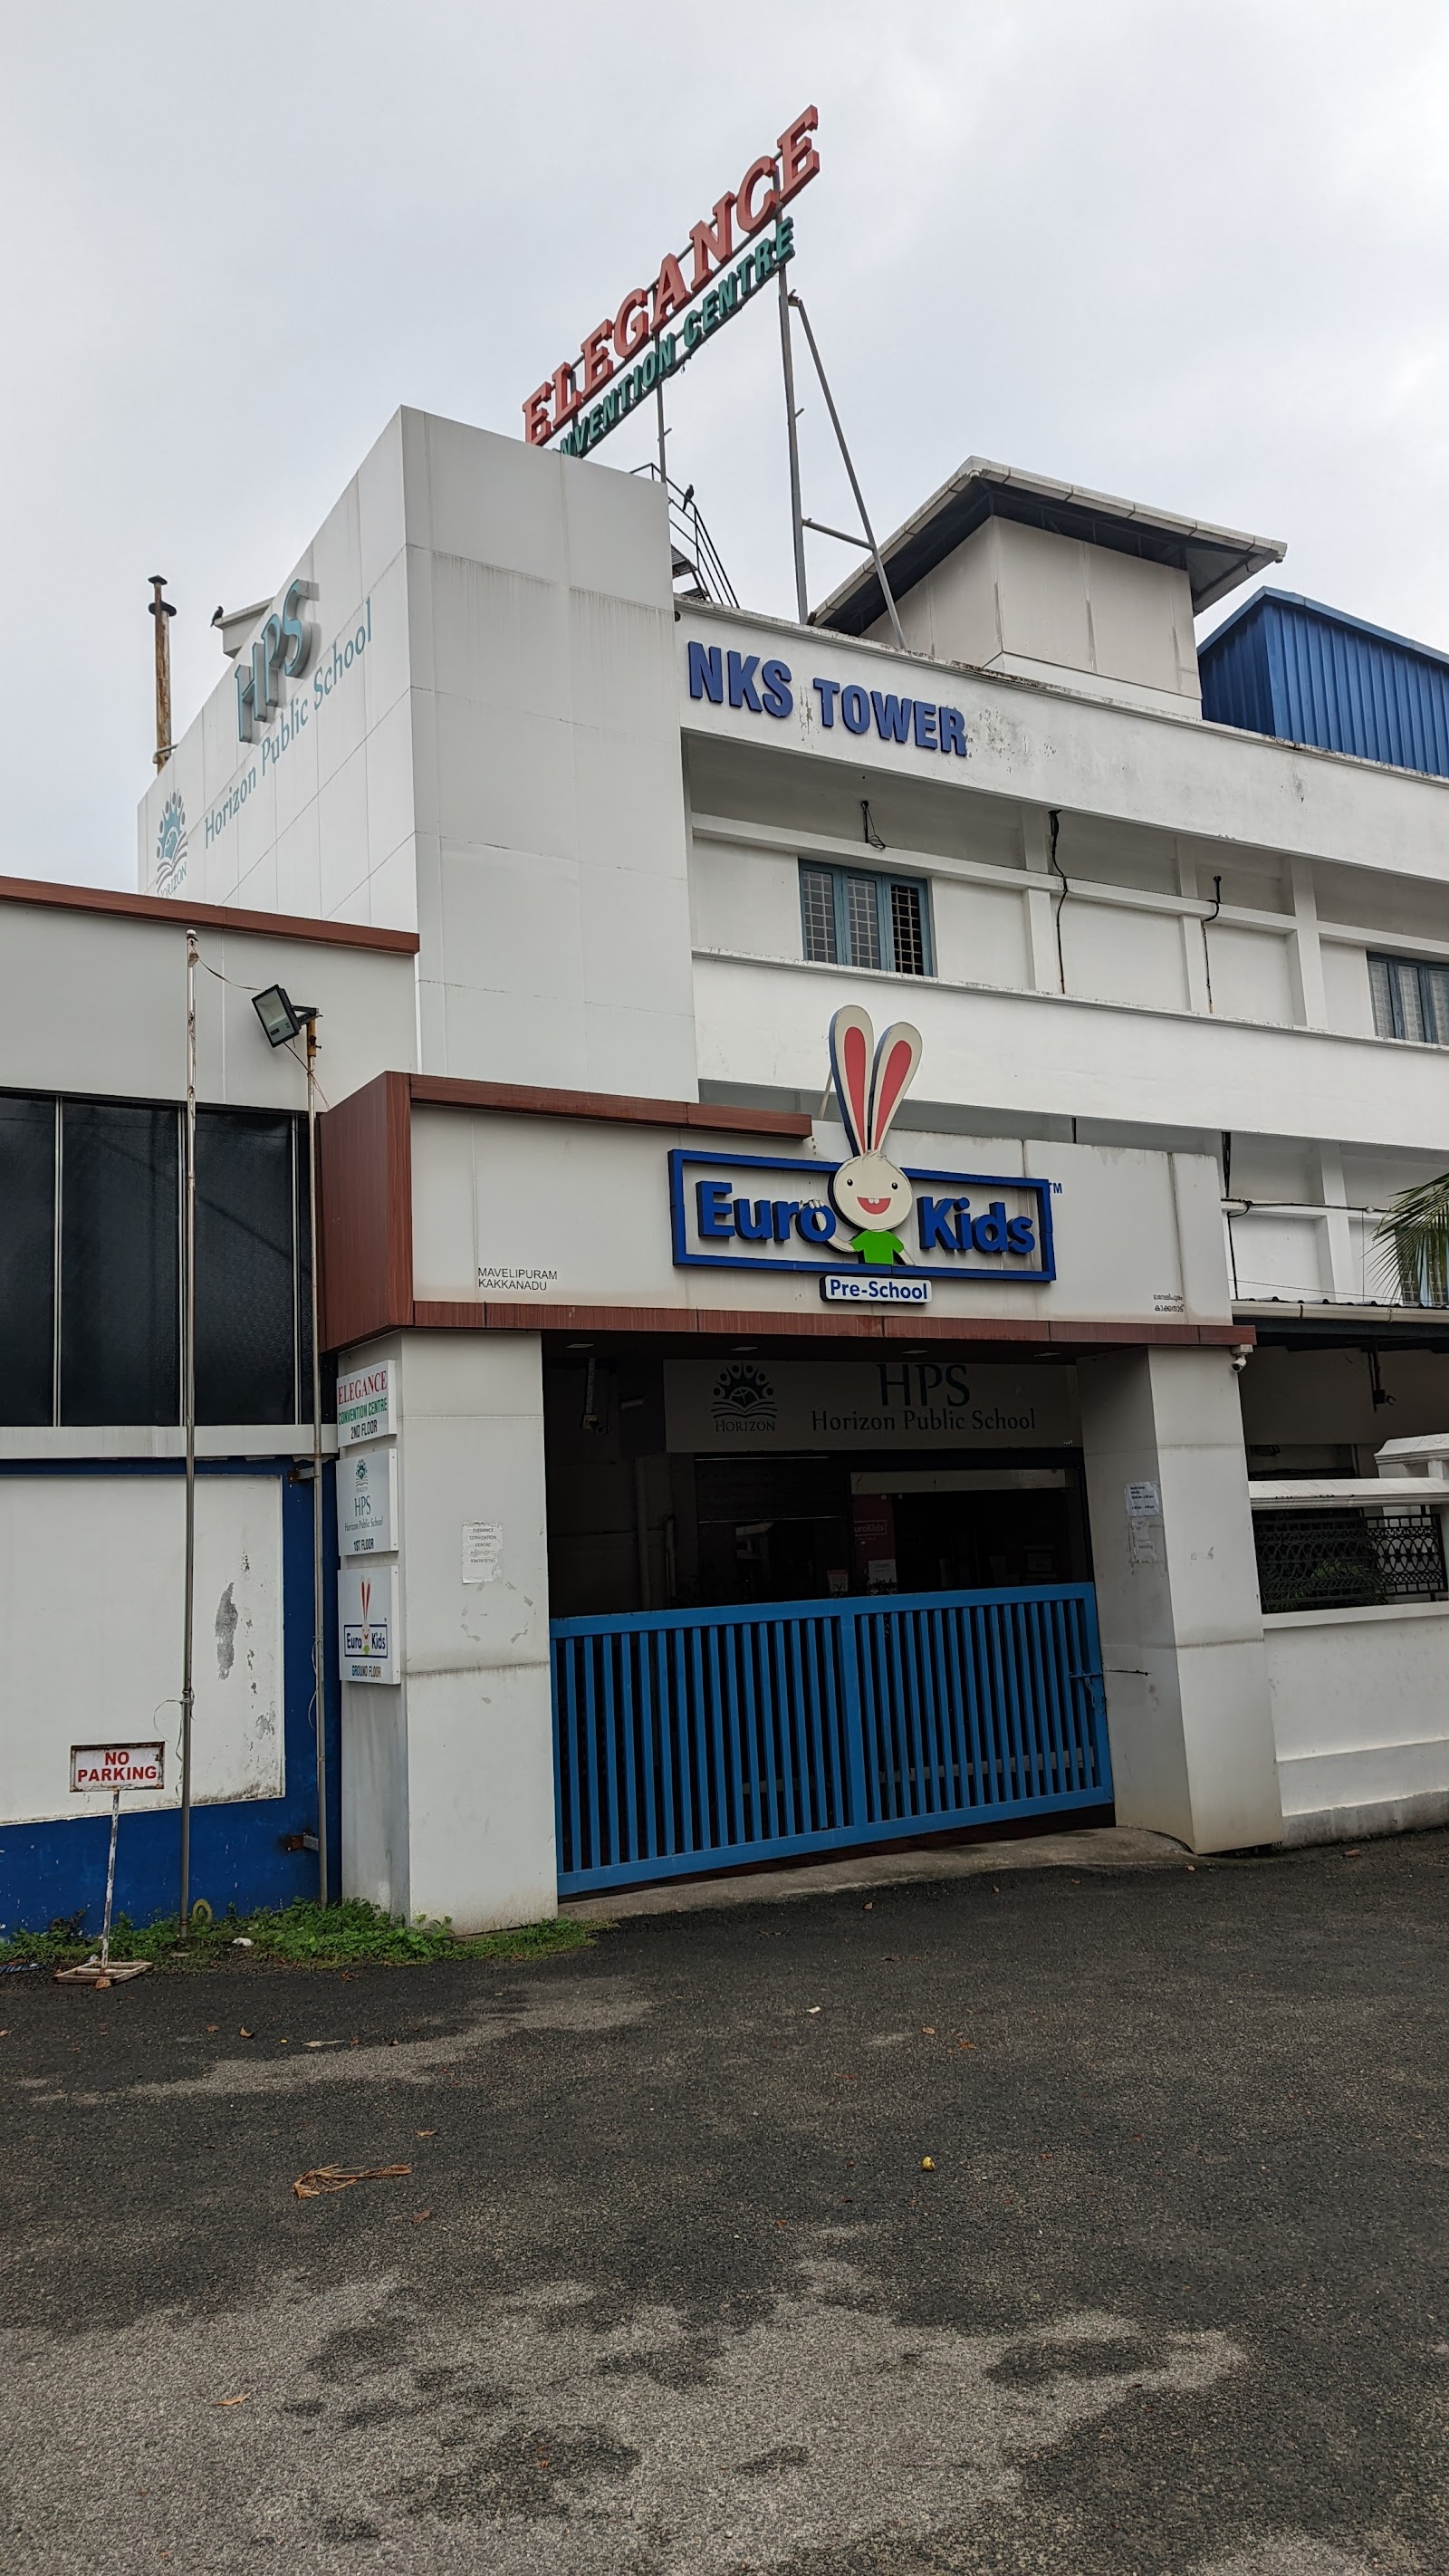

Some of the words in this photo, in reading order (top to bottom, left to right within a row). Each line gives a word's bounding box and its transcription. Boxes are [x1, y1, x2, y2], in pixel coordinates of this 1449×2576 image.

[523, 104, 820, 446] ELEGANCE
[560, 332, 677, 457] NVENTION
[683, 216, 795, 349] CENTRE
[235, 579, 314, 743] HPS
[688, 640, 793, 717] NKS
[812, 678, 967, 756] TOWER
[204, 765, 256, 850] Horizon
[261, 697, 309, 776] Public
[313, 596, 372, 710] School
[696, 1180, 837, 1243] Euro
[916, 1195, 1036, 1255] Kids
[477, 1267, 558, 1280] MAVELIPURAM
[478, 1278, 547, 1291] KAKKANADU
[830, 1279, 928, 1301] Pre-School
[338, 1370, 388, 1405] ELEGANCE
[877, 1363, 971, 1407] HPS
[339, 1403, 367, 1426] CONVENTION
[368, 1398, 388, 1416] CENTRE
[811, 1410, 896, 1431] Horizon
[905, 1408, 965, 1431] Public
[972, 1408, 1036, 1430] School
[350, 1424, 360, 1439] 2ND
[361, 1419, 378, 1437] FLOOR
[715, 1419, 776, 1432] HORIZON
[354, 1495, 371, 1516] HPS
[854, 1523, 885, 1533] uroKids
[361, 1538, 374, 1550] FLOOR
[347, 1632, 362, 1648] Euro
[371, 1632, 385, 1649] Kids
[351, 1665, 368, 1677] GROUND
[369, 1666, 381, 1677] FLOOR
[104, 1751, 130, 1766] NO
[77, 1765, 158, 1783] PARKING
